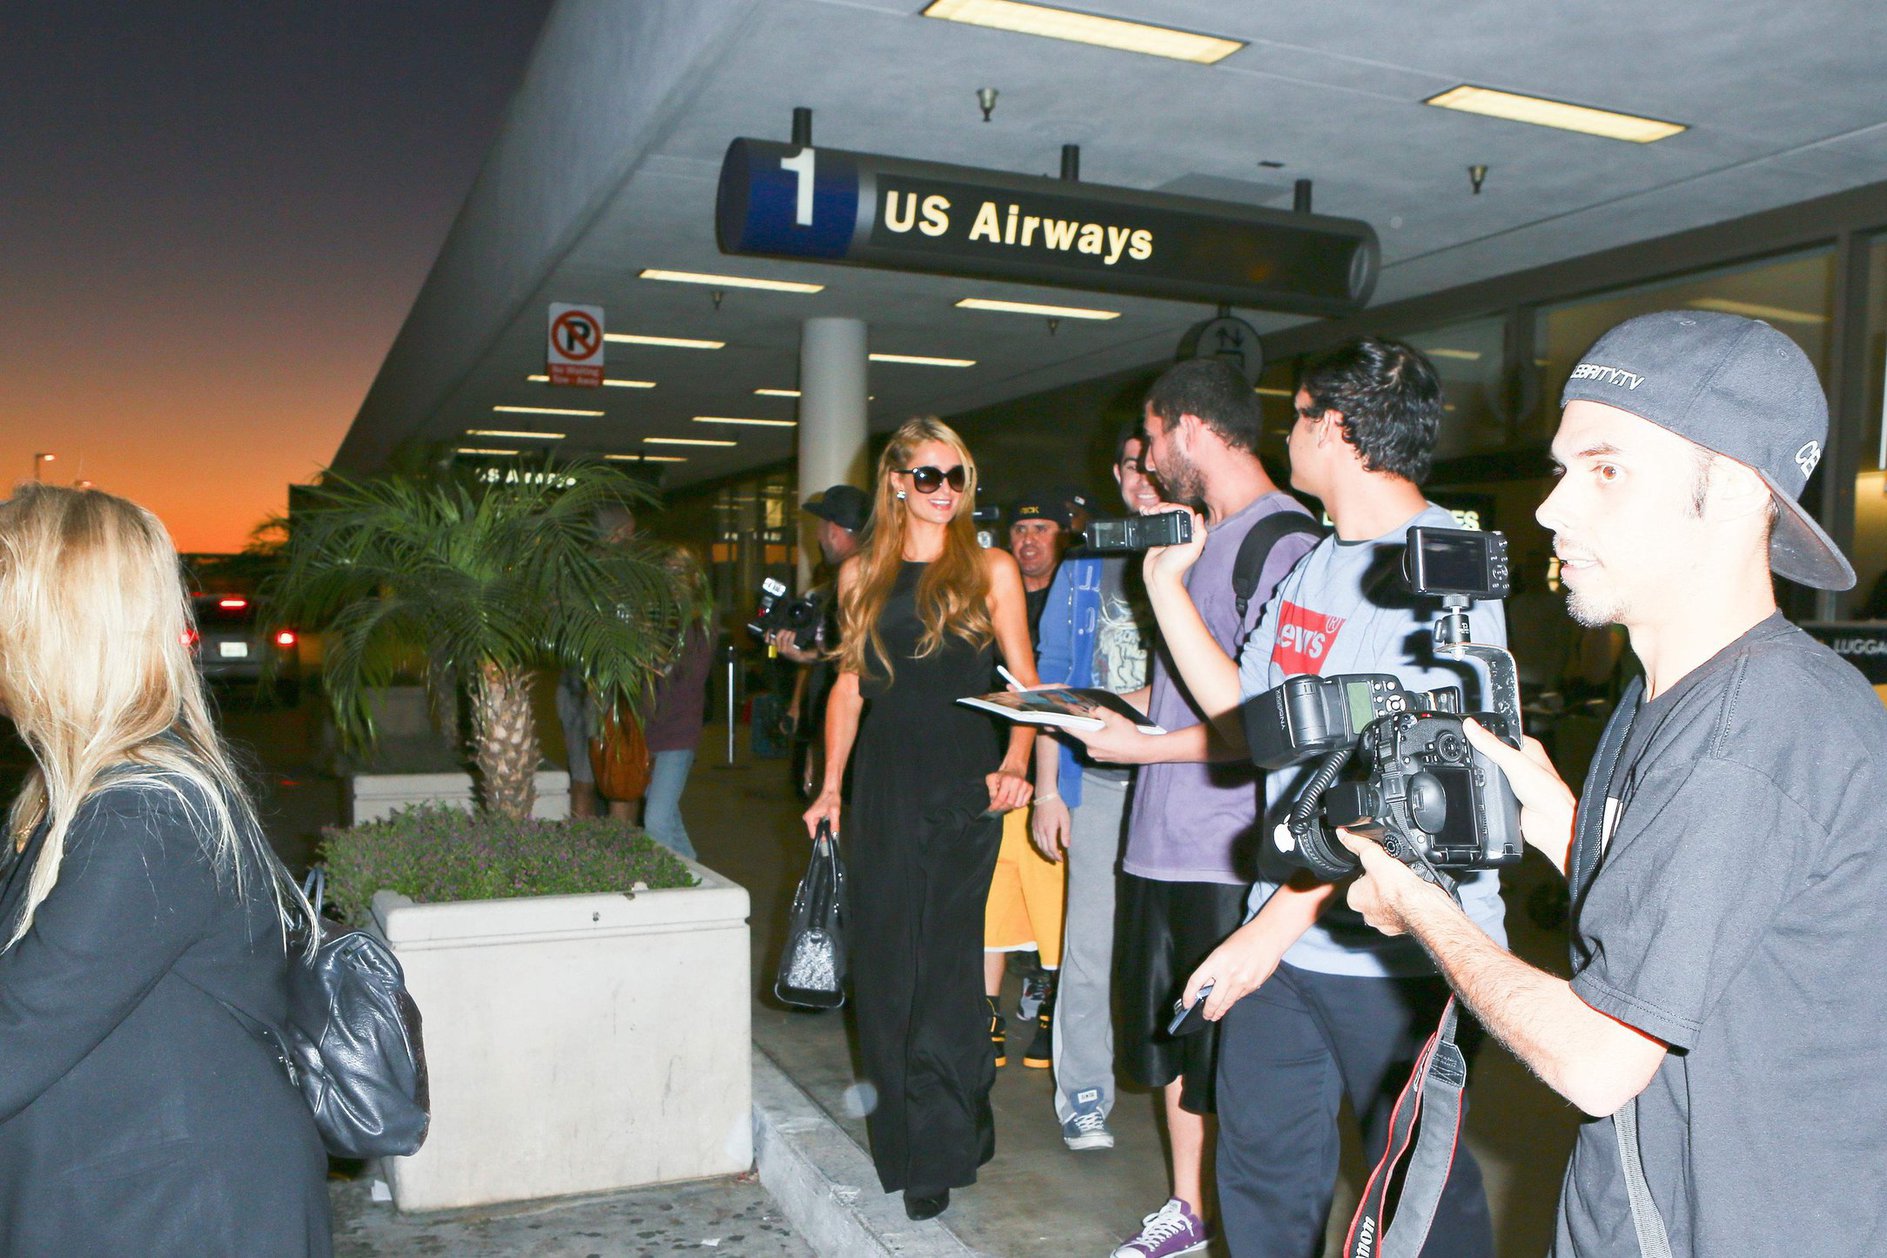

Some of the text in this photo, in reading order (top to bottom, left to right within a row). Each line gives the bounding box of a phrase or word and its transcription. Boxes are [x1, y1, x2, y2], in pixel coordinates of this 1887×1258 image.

[780, 147, 815, 226] 1
[884, 190, 1154, 265] US Airways
[1355, 1215, 1376, 1258] non
